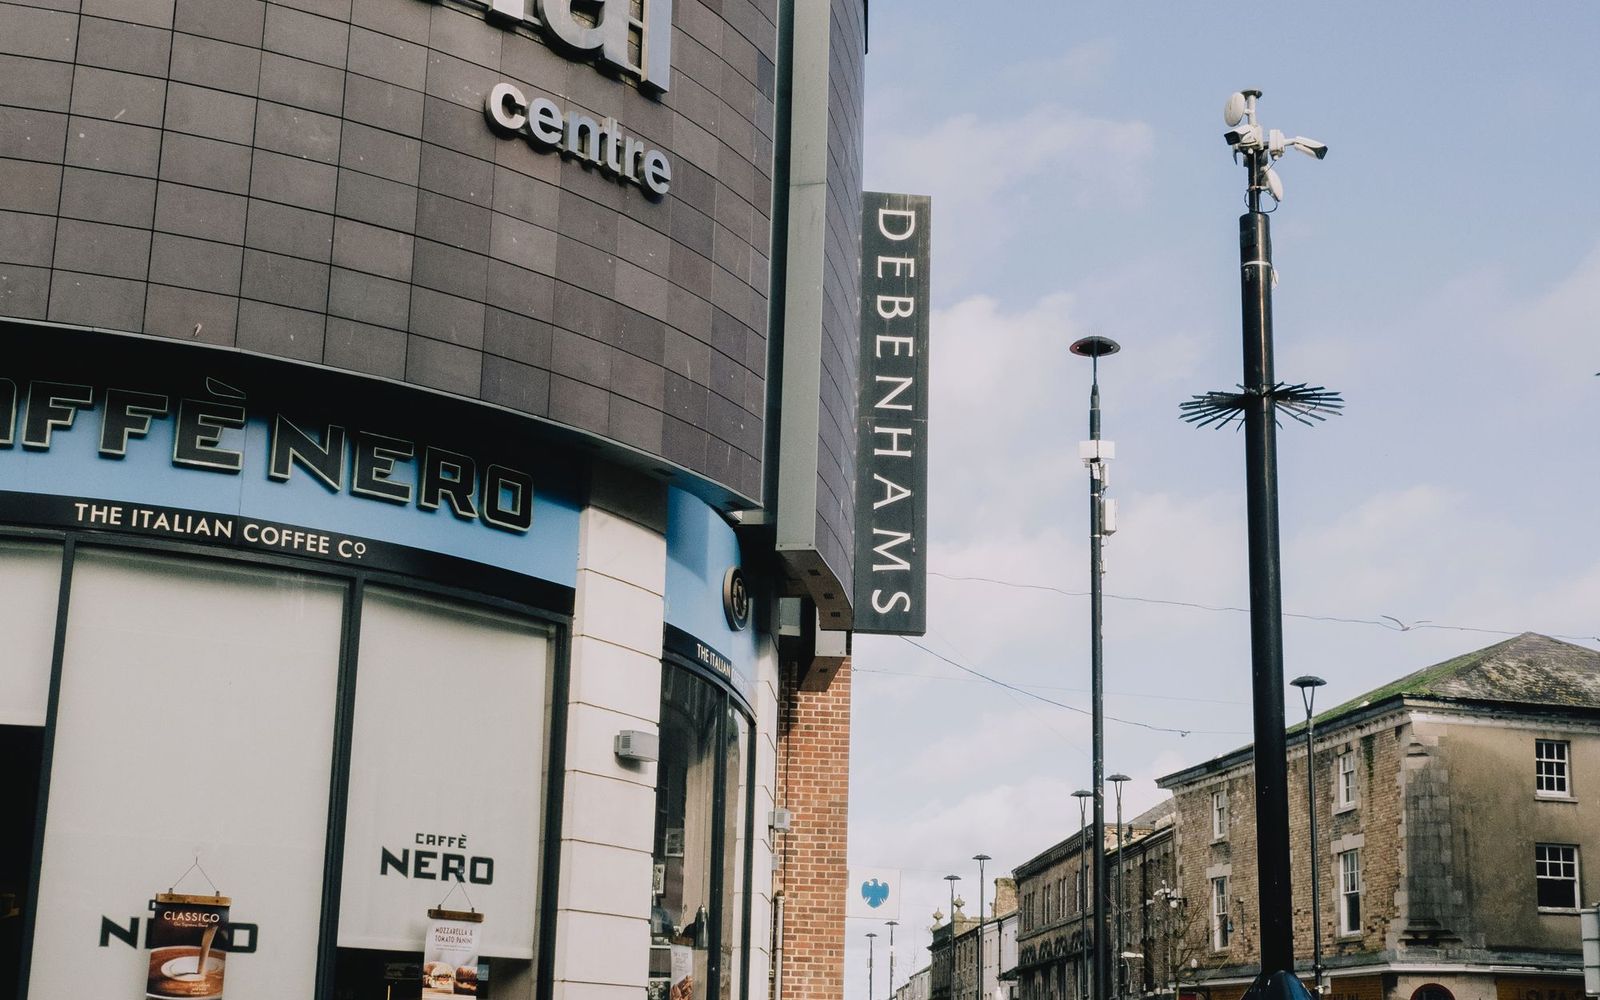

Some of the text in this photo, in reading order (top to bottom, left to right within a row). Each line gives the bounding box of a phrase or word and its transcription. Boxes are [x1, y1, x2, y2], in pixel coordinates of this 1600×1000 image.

[486, 82, 672, 196] centre
[872, 207, 916, 615] DEBENHAMS
[0, 377, 534, 533] FFÈ NERO
[74, 503, 122, 526] THE
[132, 508, 234, 539] ITALIAN
[243, 523, 333, 555] COFFEE
[697, 643, 731, 678] THE ITALIAN
[416, 833, 467, 849] CAFFÈ
[380, 846, 494, 885] NERO
[98, 914, 259, 953] NO
[163, 911, 220, 923] CLASSICO
[435, 927, 468, 936] MOZZARELLA
[435, 935, 454, 943] TOMATO
